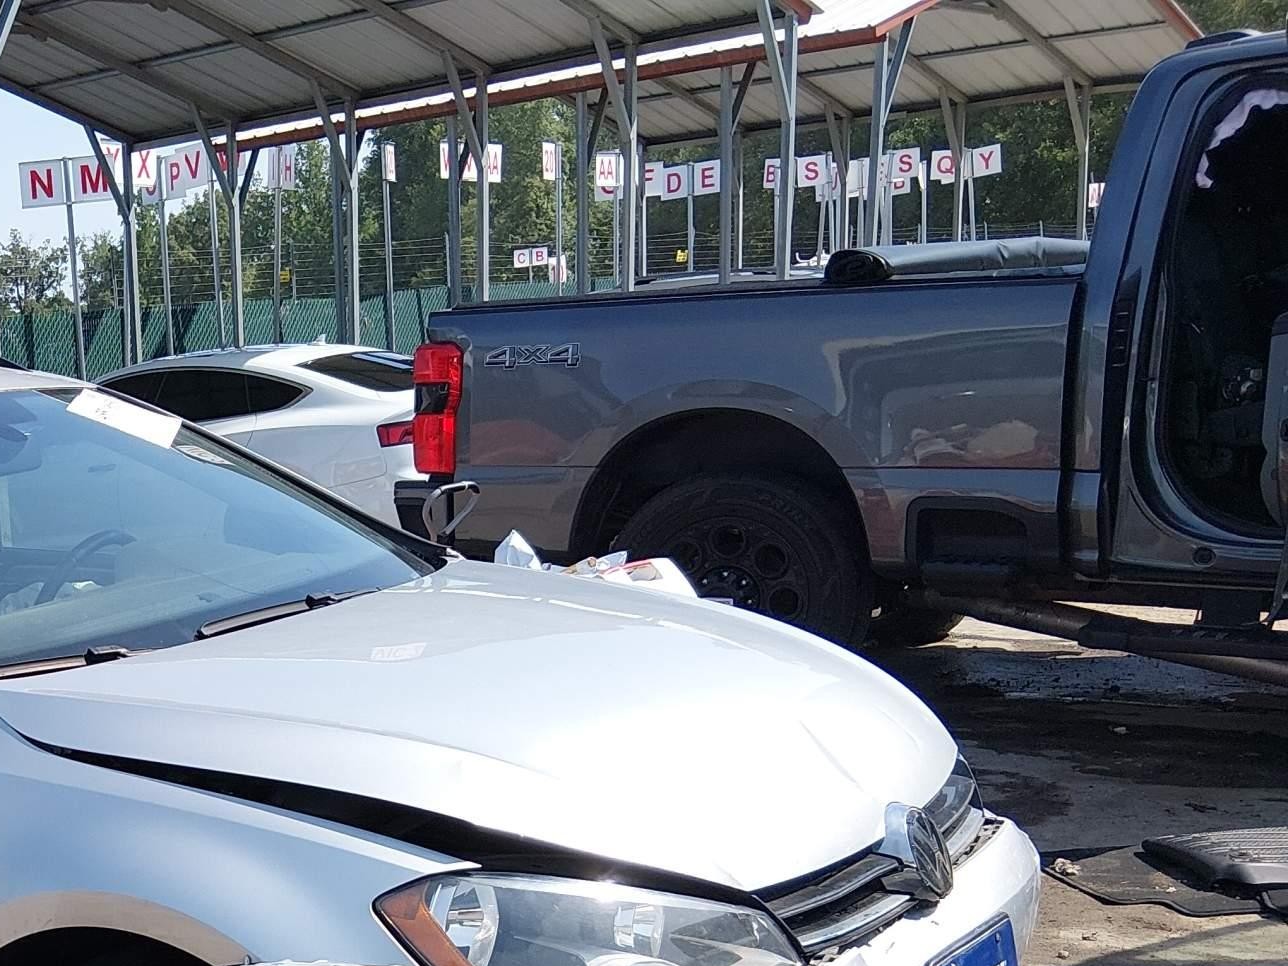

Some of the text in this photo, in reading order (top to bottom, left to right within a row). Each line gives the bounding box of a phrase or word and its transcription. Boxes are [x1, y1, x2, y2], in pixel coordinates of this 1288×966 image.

[137, 151, 150, 178] X
[185, 151, 200, 179] V
[284, 154, 292, 181] H
[599, 158, 614, 180] AA
[899, 154, 912, 172] S
[937, 156, 955, 175] Q
[979, 151, 994, 169] Y
[80, 164, 109, 194] M
[702, 167, 715, 188] E
[805, 162, 818, 180] S
[30, 168, 53, 199] N
[667, 173, 682, 193] D
[517, 253, 526, 264] C
[536, 251, 544, 261] B
